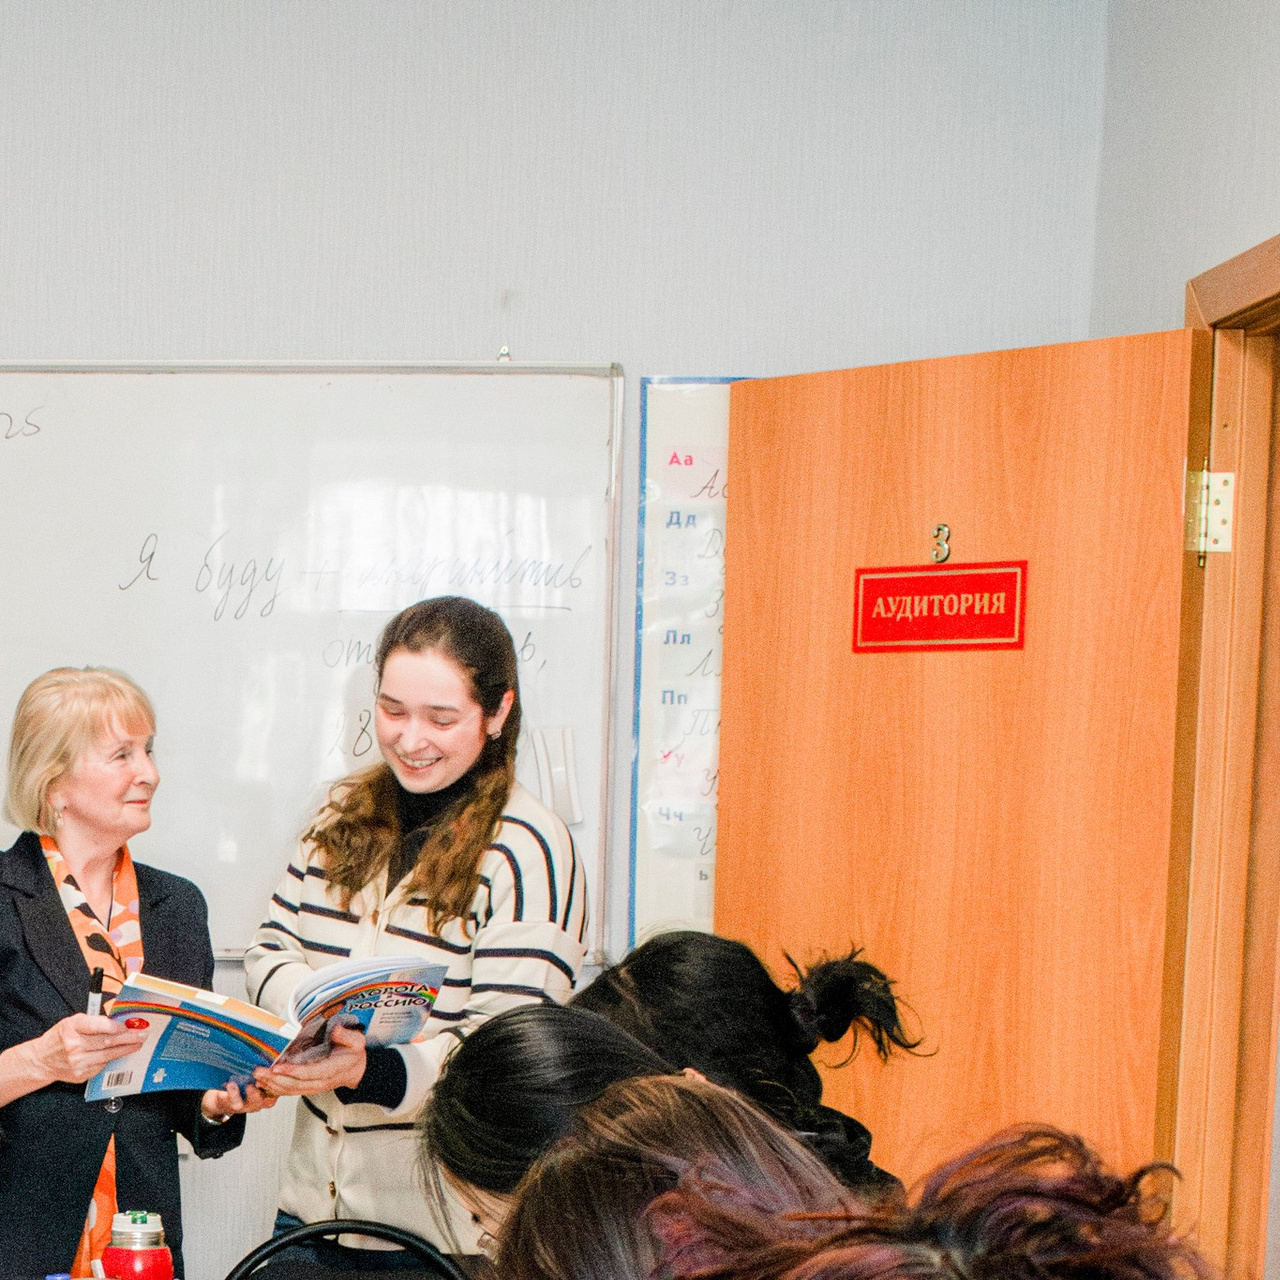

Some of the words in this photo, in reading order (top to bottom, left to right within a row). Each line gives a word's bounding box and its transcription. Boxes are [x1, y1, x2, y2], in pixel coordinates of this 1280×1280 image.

[930, 523, 951, 563] 3
[118, 532, 160, 591] Я
[195, 530, 287, 622] буду
[872, 592, 1007, 622] АУДИТОРИЯ
[348, 997, 429, 1012] РОССИЮ
[352, 984, 429, 1001] ДОРОГА
